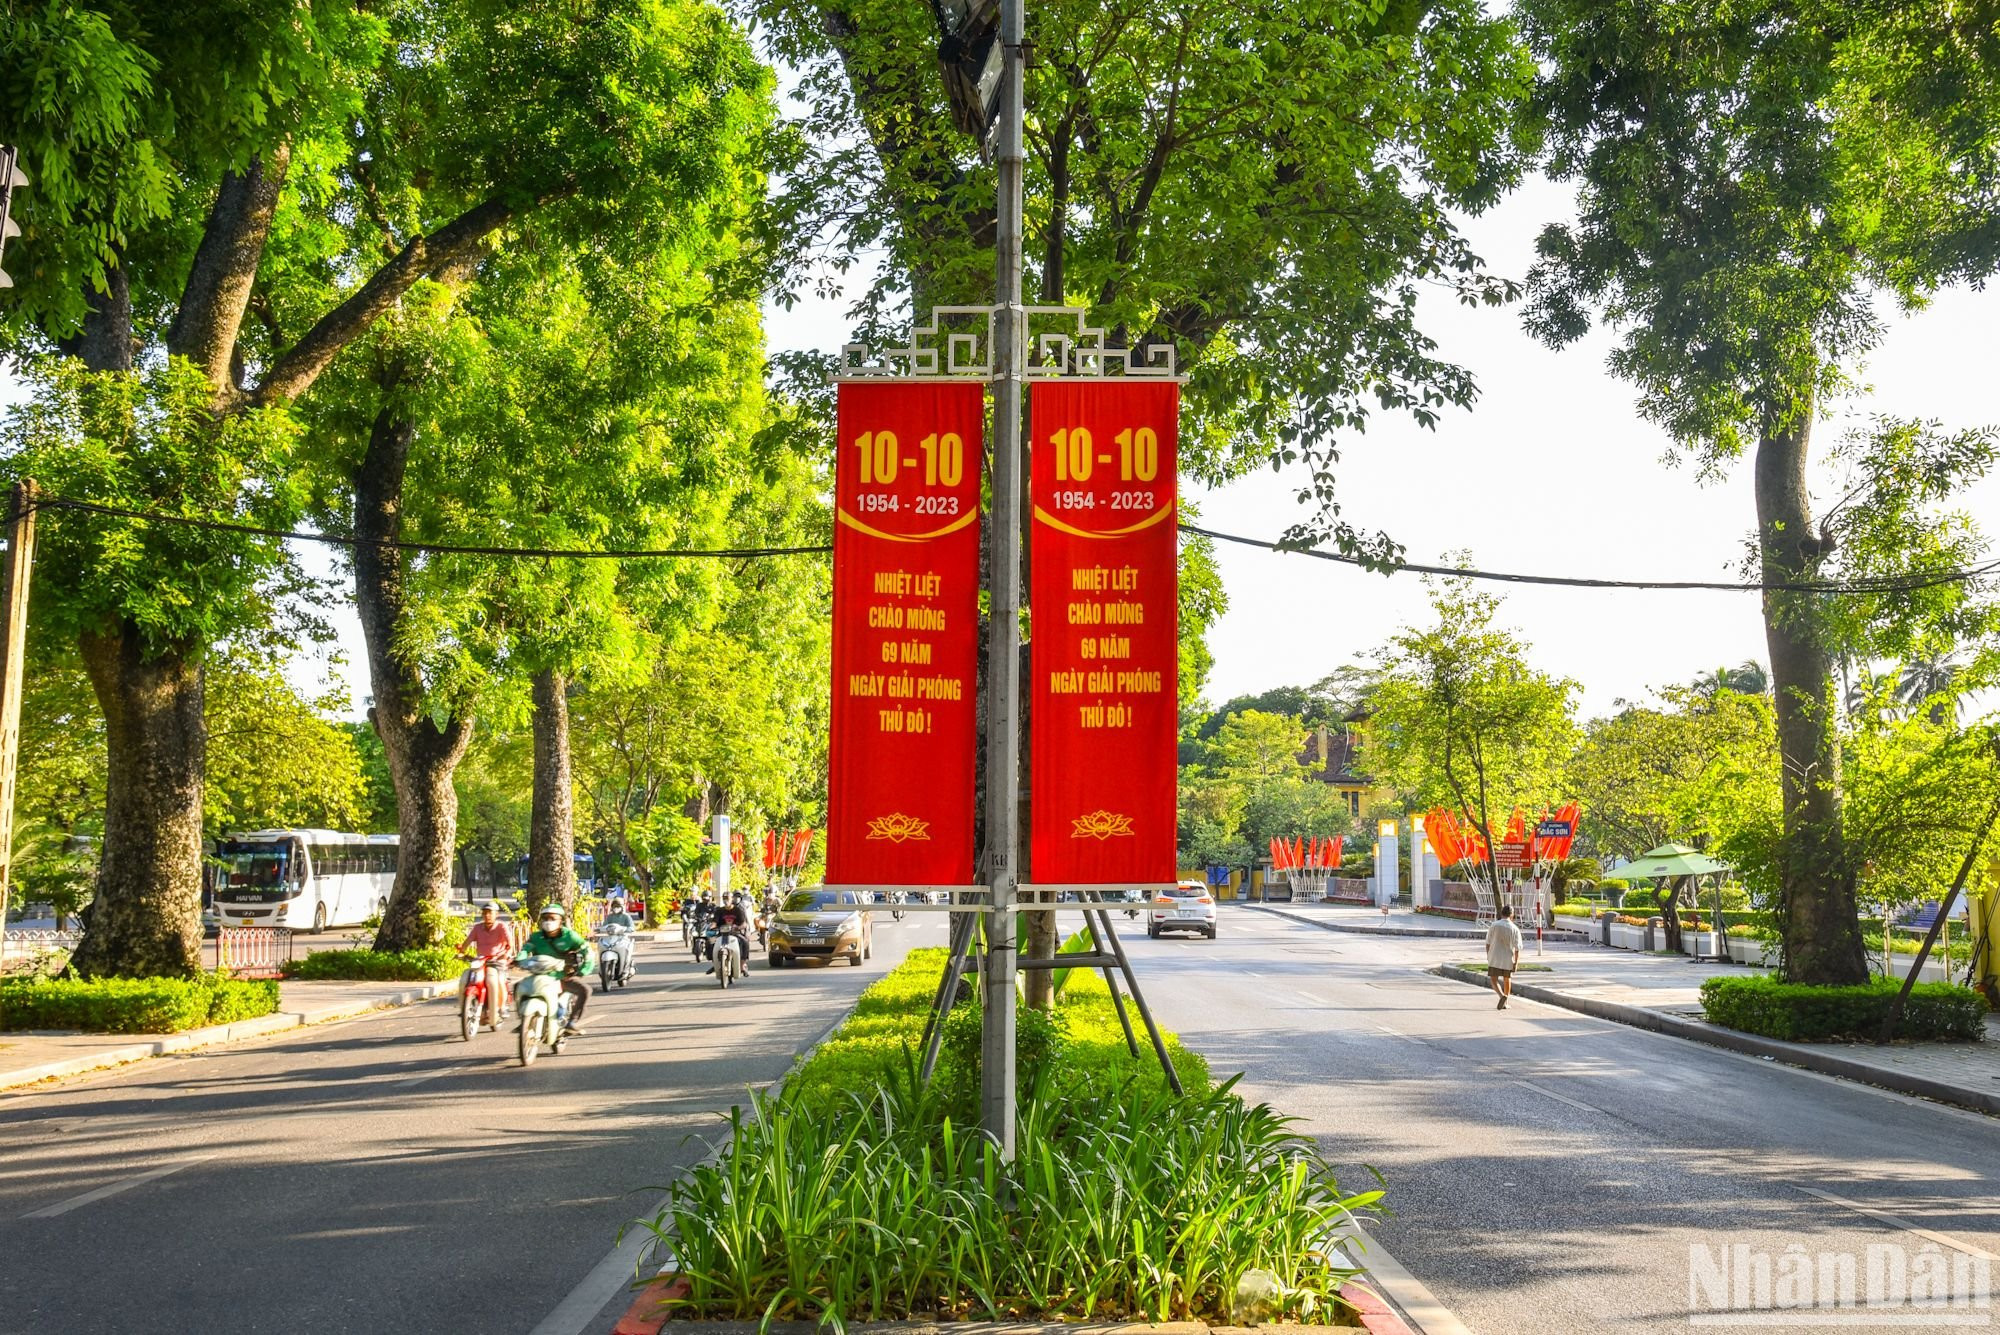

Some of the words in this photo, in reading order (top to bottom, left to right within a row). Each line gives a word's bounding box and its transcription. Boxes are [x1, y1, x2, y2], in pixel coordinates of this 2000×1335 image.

[874, 569, 911, 600] NHIỆT
[915, 570, 942, 601] LIỆT
[1072, 565, 1109, 595] NHIỆT
[1112, 565, 1139, 595] LIỆT
[868, 604, 904, 629] CHÀO
[906, 605, 946, 632] MỪNG
[1067, 598, 1102, 625] CHÀO
[1104, 600, 1144, 625] MỪNG
[881, 641, 898, 663] 69
[900, 638, 931, 665] NĂM
[1080, 637, 1097, 659] 69
[1099, 634, 1130, 659] NĂM
[849, 674, 885, 698] NGÀY
[887, 671, 913, 698] GIẢI
[917, 676, 962, 701] PHÓNG
[1050, 670, 1085, 694] NGÀY
[1087, 665, 1114, 693] GIẢI
[1117, 670, 1161, 694] PHÓNG
[879, 704, 904, 733] THỦ
[1079, 698, 1104, 728] THỦ
